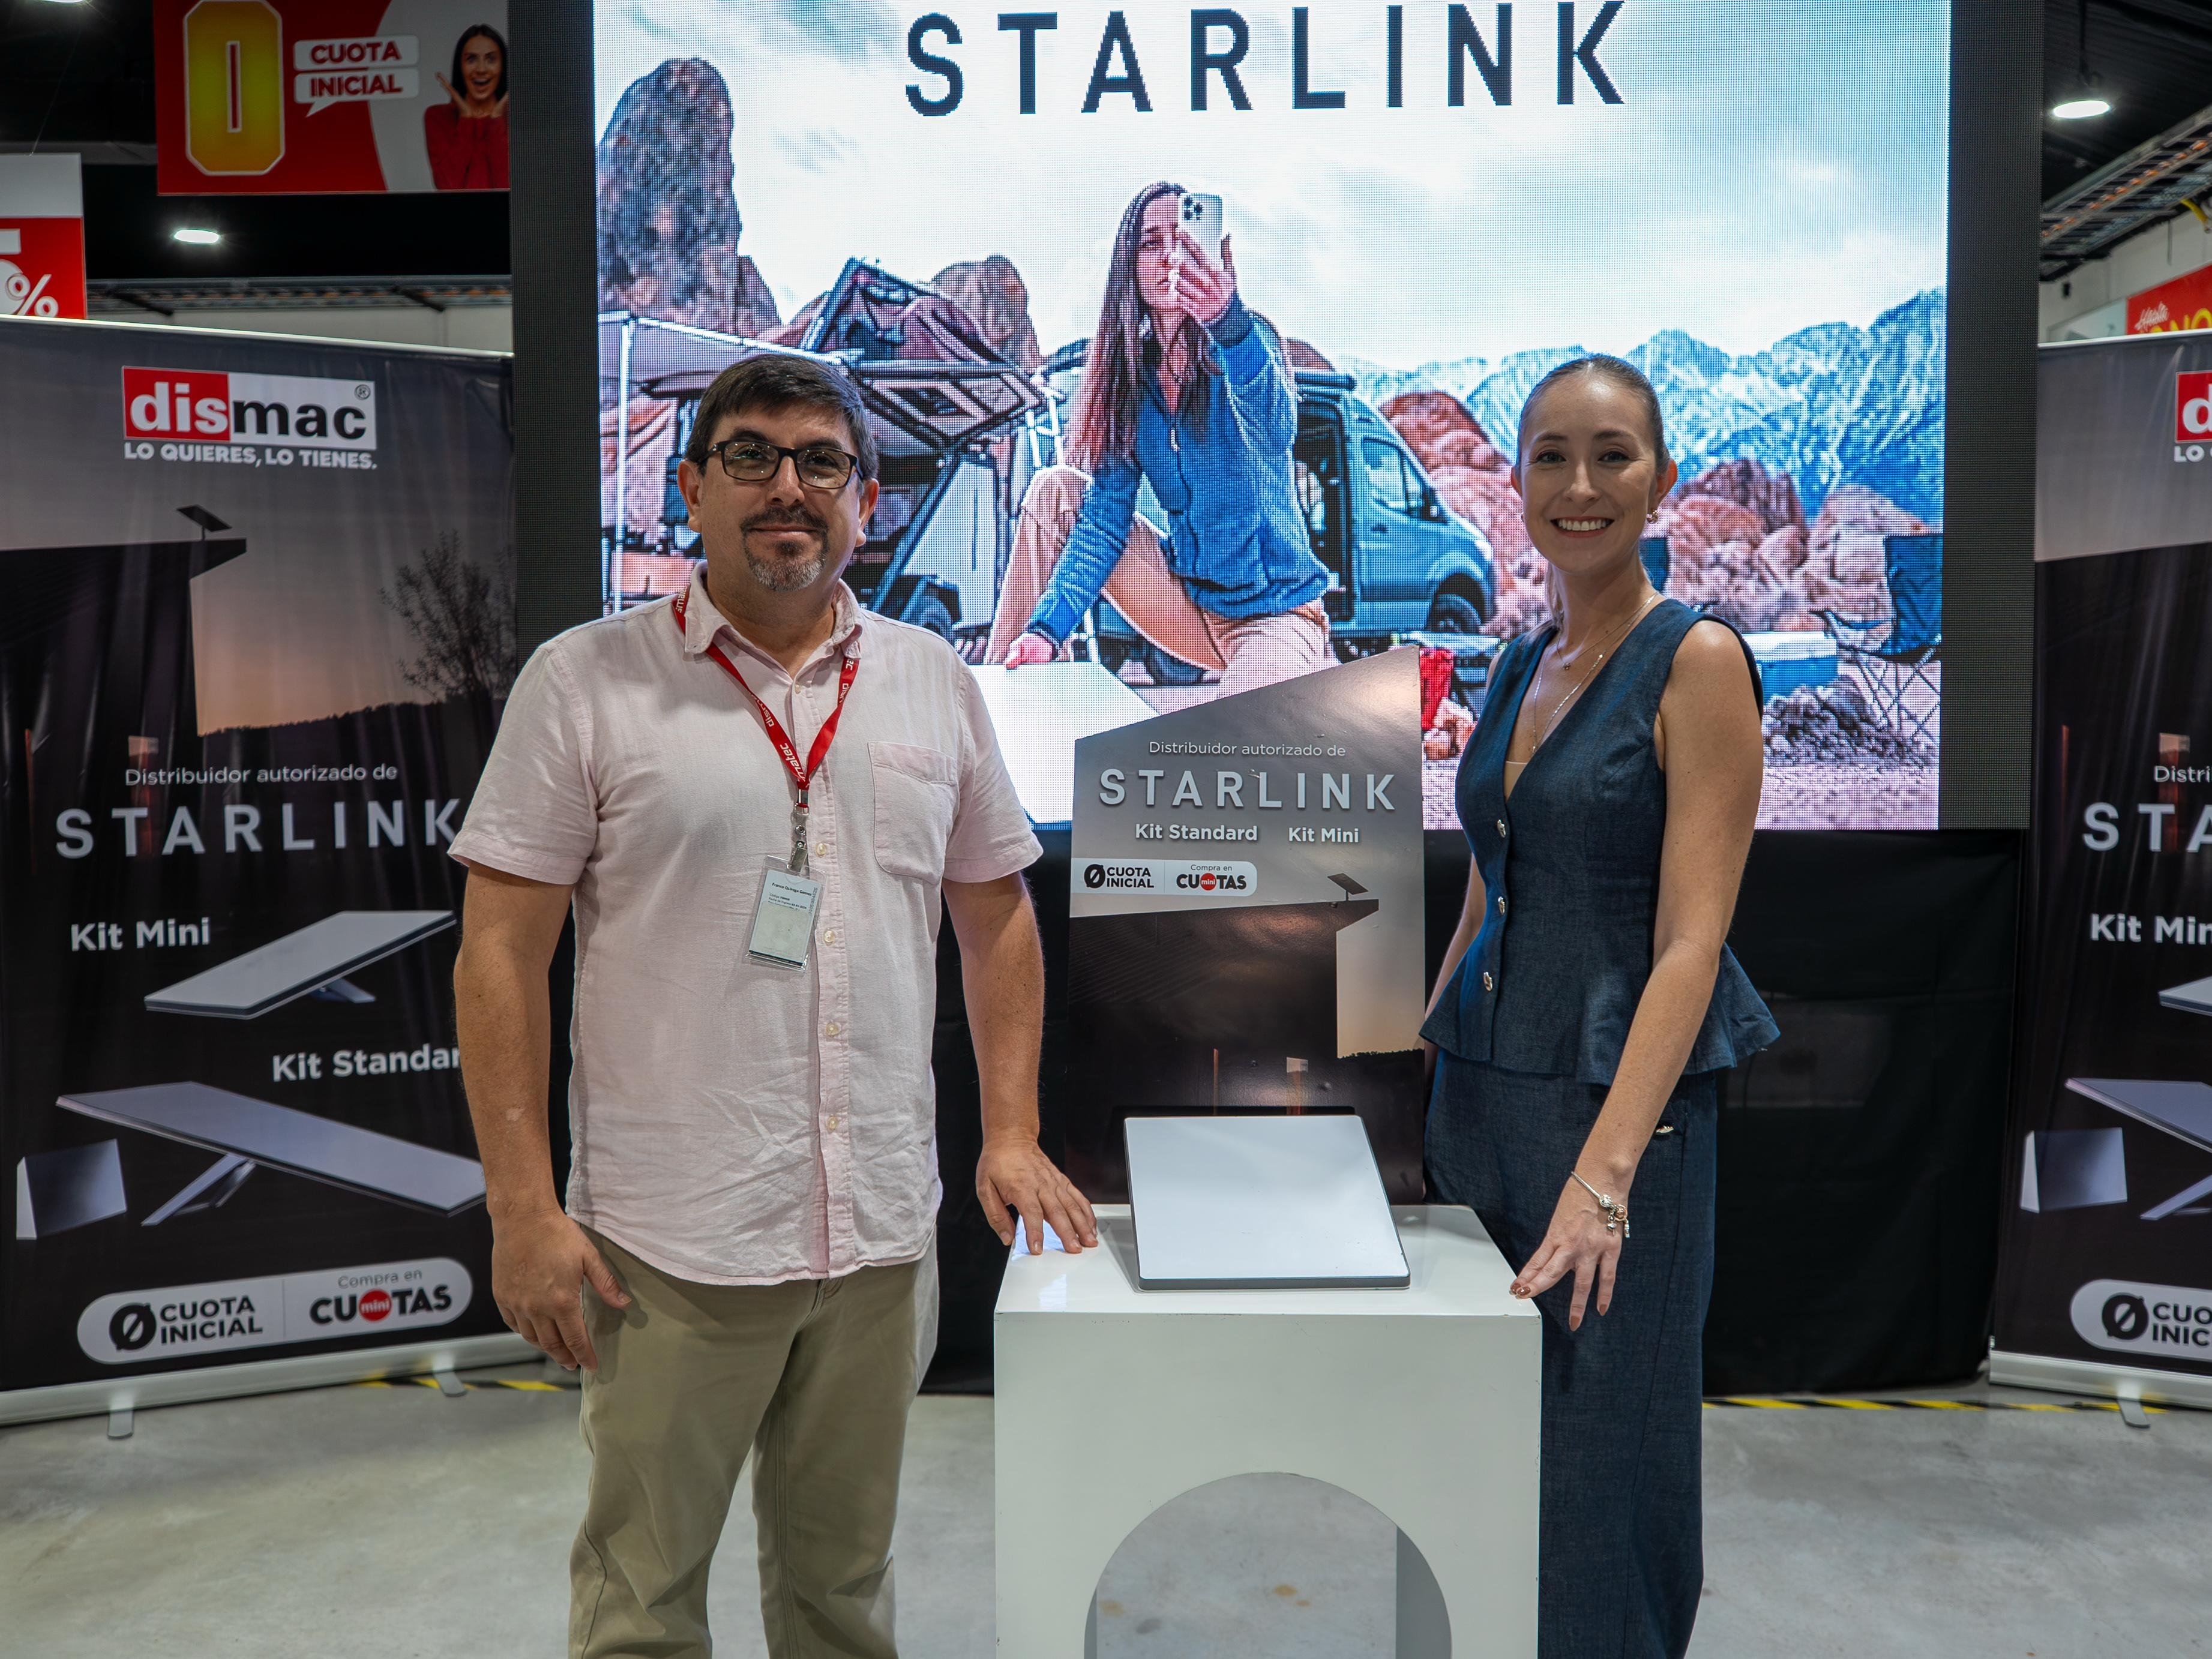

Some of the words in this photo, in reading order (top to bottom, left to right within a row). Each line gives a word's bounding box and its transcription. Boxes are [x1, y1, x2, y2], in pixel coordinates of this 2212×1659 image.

[310, 40, 400, 64] CUOTA
[906, 0, 1625, 116] STARLINK
[310, 74, 403, 97] INICIAL
[130, 382, 366, 440] dismac
[124, 442, 154, 460] LO
[161, 443, 262, 467] QUIERES,
[265, 447, 292, 466] LO
[299, 449, 377, 469] TIENES.
[2174, 446, 2204, 463] LO
[1150, 742, 1237, 755] Distribuidor
[1242, 743, 1321, 756] autorizado
[1327, 745, 1346, 757] de
[126, 766, 250, 785] Distribuidor
[257, 764, 366, 782] autorizado
[373, 763, 398, 779] de
[1099, 768, 1395, 811] STARLINK
[56, 798, 460, 859] STARLINK
[1135, 824, 1162, 839] Kit
[1169, 824, 1258, 841] Standard
[1288, 827, 1314, 842] Kit
[1321, 827, 1359, 843] Mini
[1107, 867, 1151, 878] CUOTA
[1191, 864, 1221, 872] Compra
[1107, 877, 1154, 888] INICIAL
[71, 923, 122, 951] Kit
[136, 917, 210, 947] Mini
[2091, 914, 2141, 942] Kit
[273, 1054, 322, 1081] Kit
[333, 1044, 460, 1076] Standar
[337, 1271, 399, 1289] Compra
[404, 1270, 422, 1280] en
[161, 1295, 256, 1321] CUOTA
[361, 1297, 390, 1313] mini
[161, 1317, 263, 1344] INICIAL
